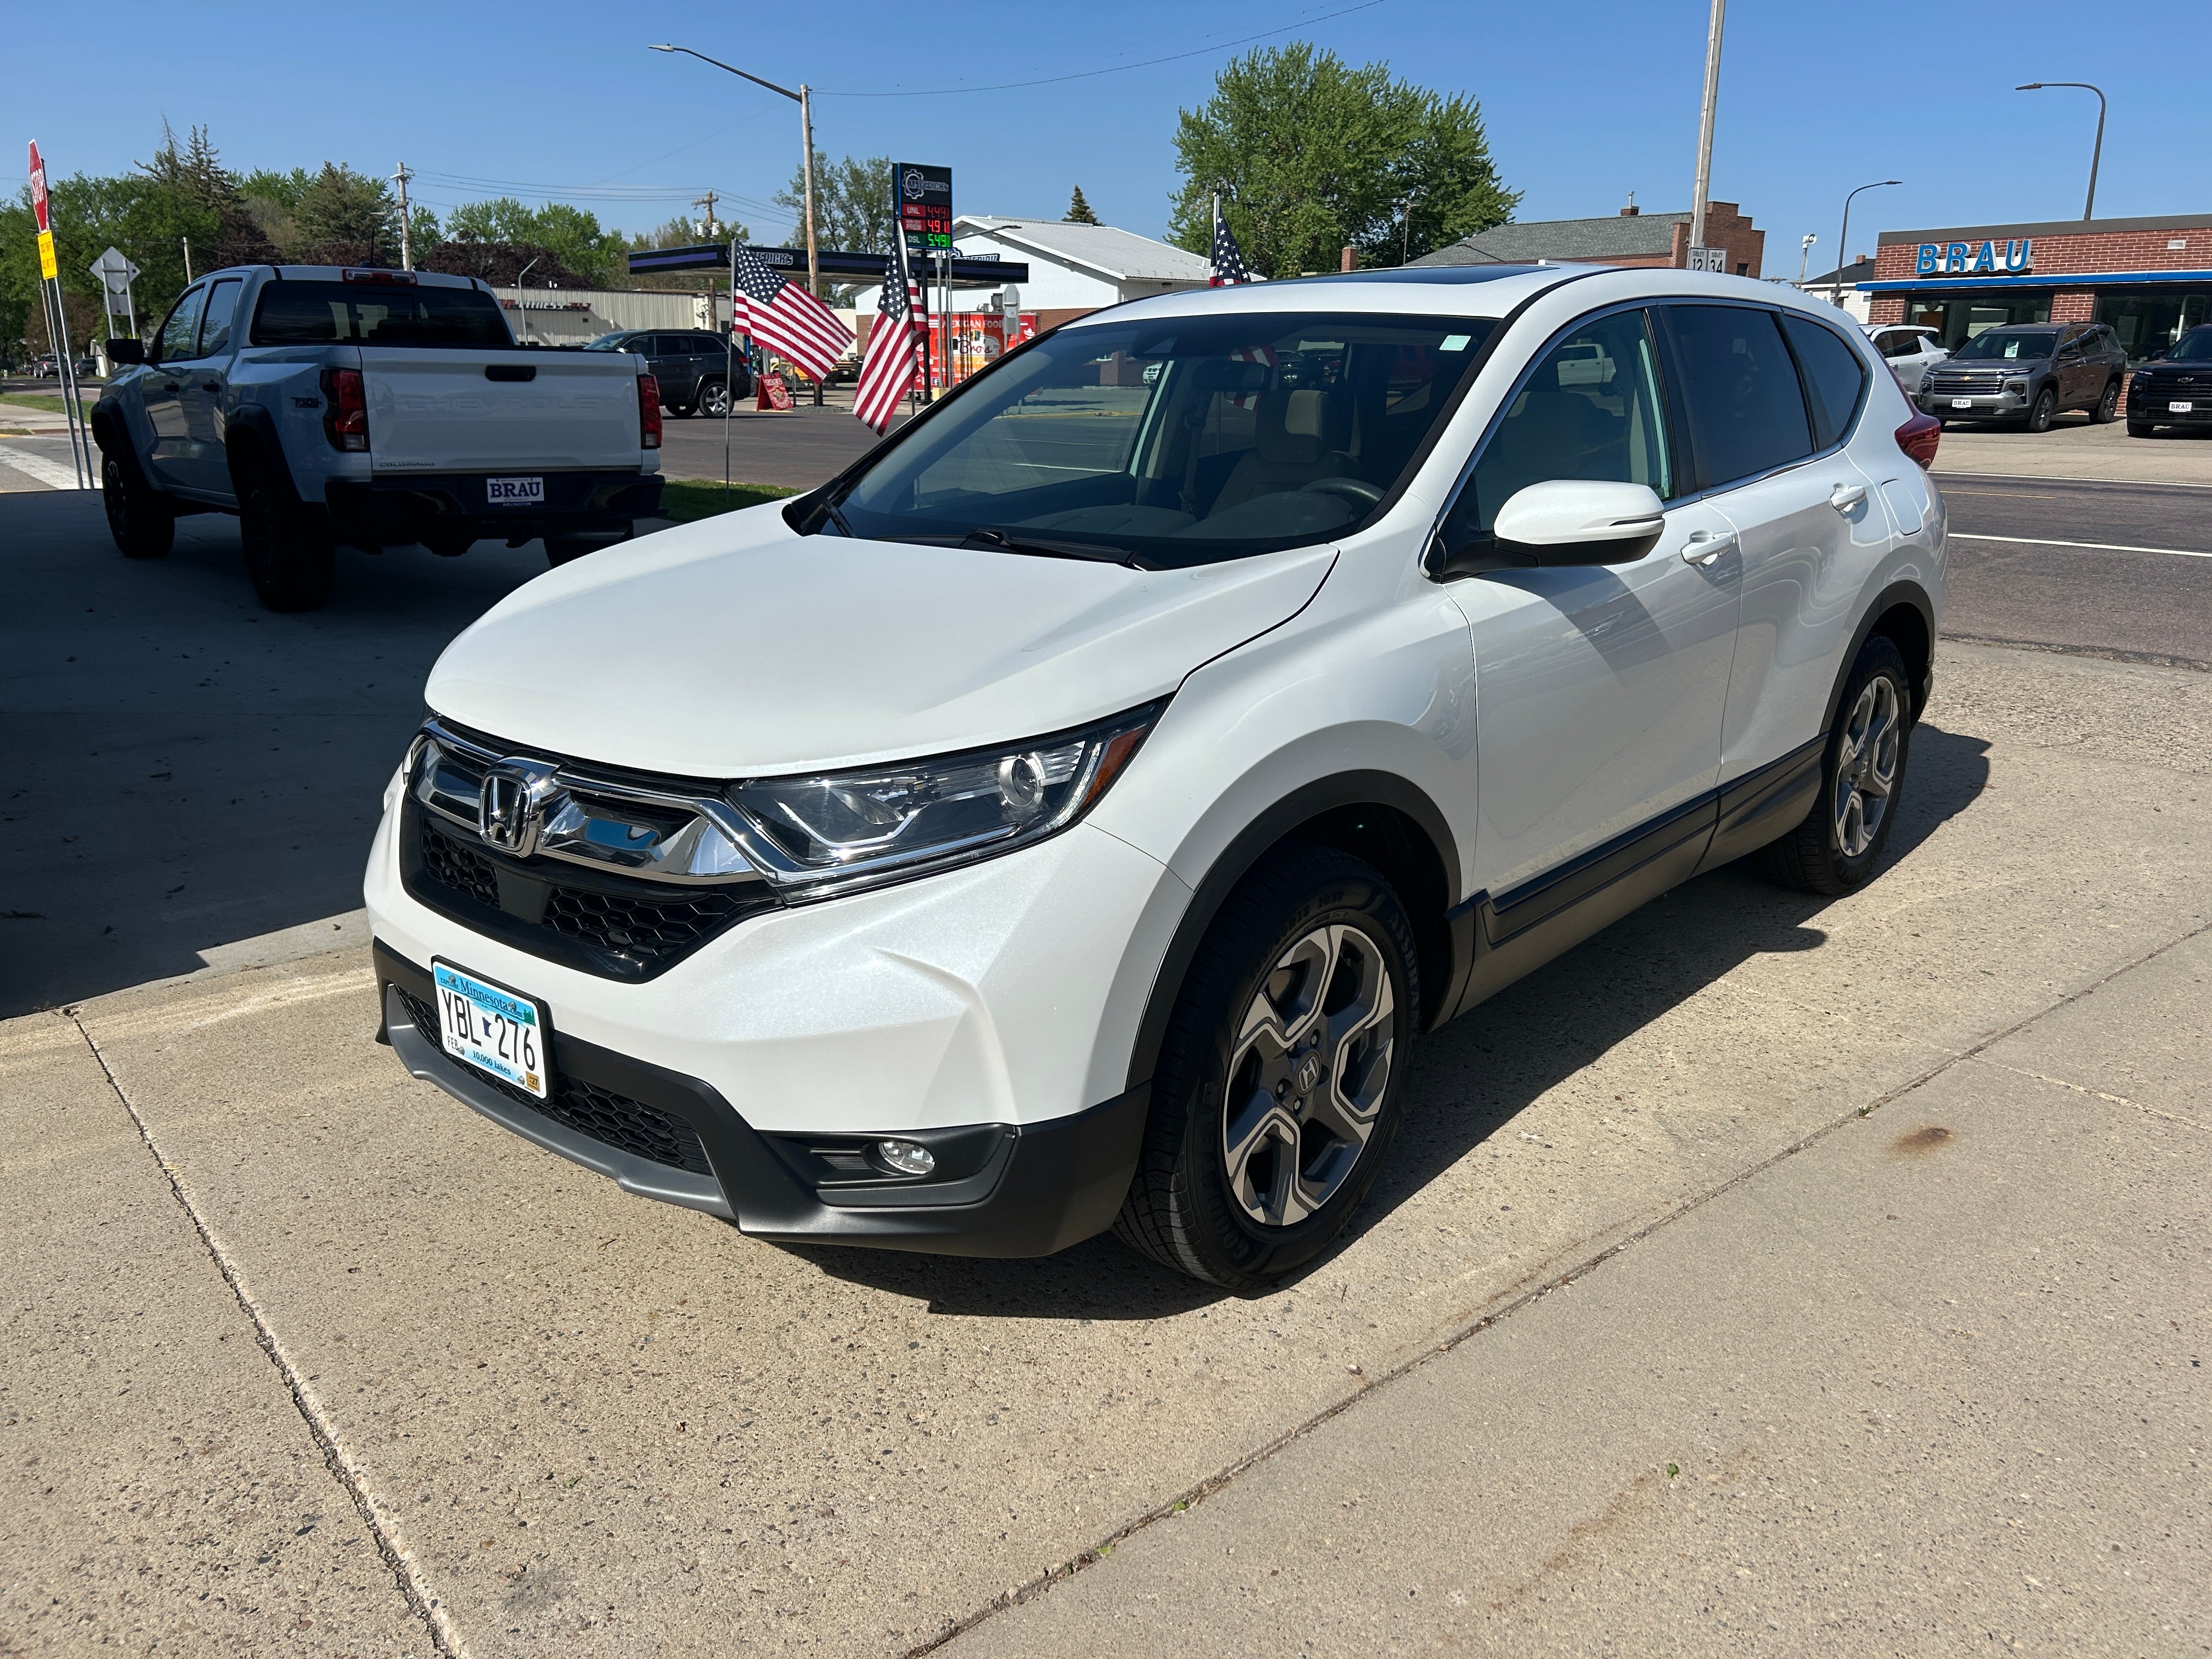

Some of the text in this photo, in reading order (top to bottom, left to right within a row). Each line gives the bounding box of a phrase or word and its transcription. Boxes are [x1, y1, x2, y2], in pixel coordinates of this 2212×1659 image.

[31, 168, 44, 205] STOP
[1693, 258, 1702, 270] 12
[1915, 239, 2032, 274] BRAU
[1711, 259, 1722, 273] 34
[490, 482, 541, 498] BRAU
[441, 989, 535, 1071] YBL 276
[447, 1035, 459, 1051] FEB
[472, 1050, 511, 1075] 10,000 lakes
[531, 1077, 538, 1086] 27
